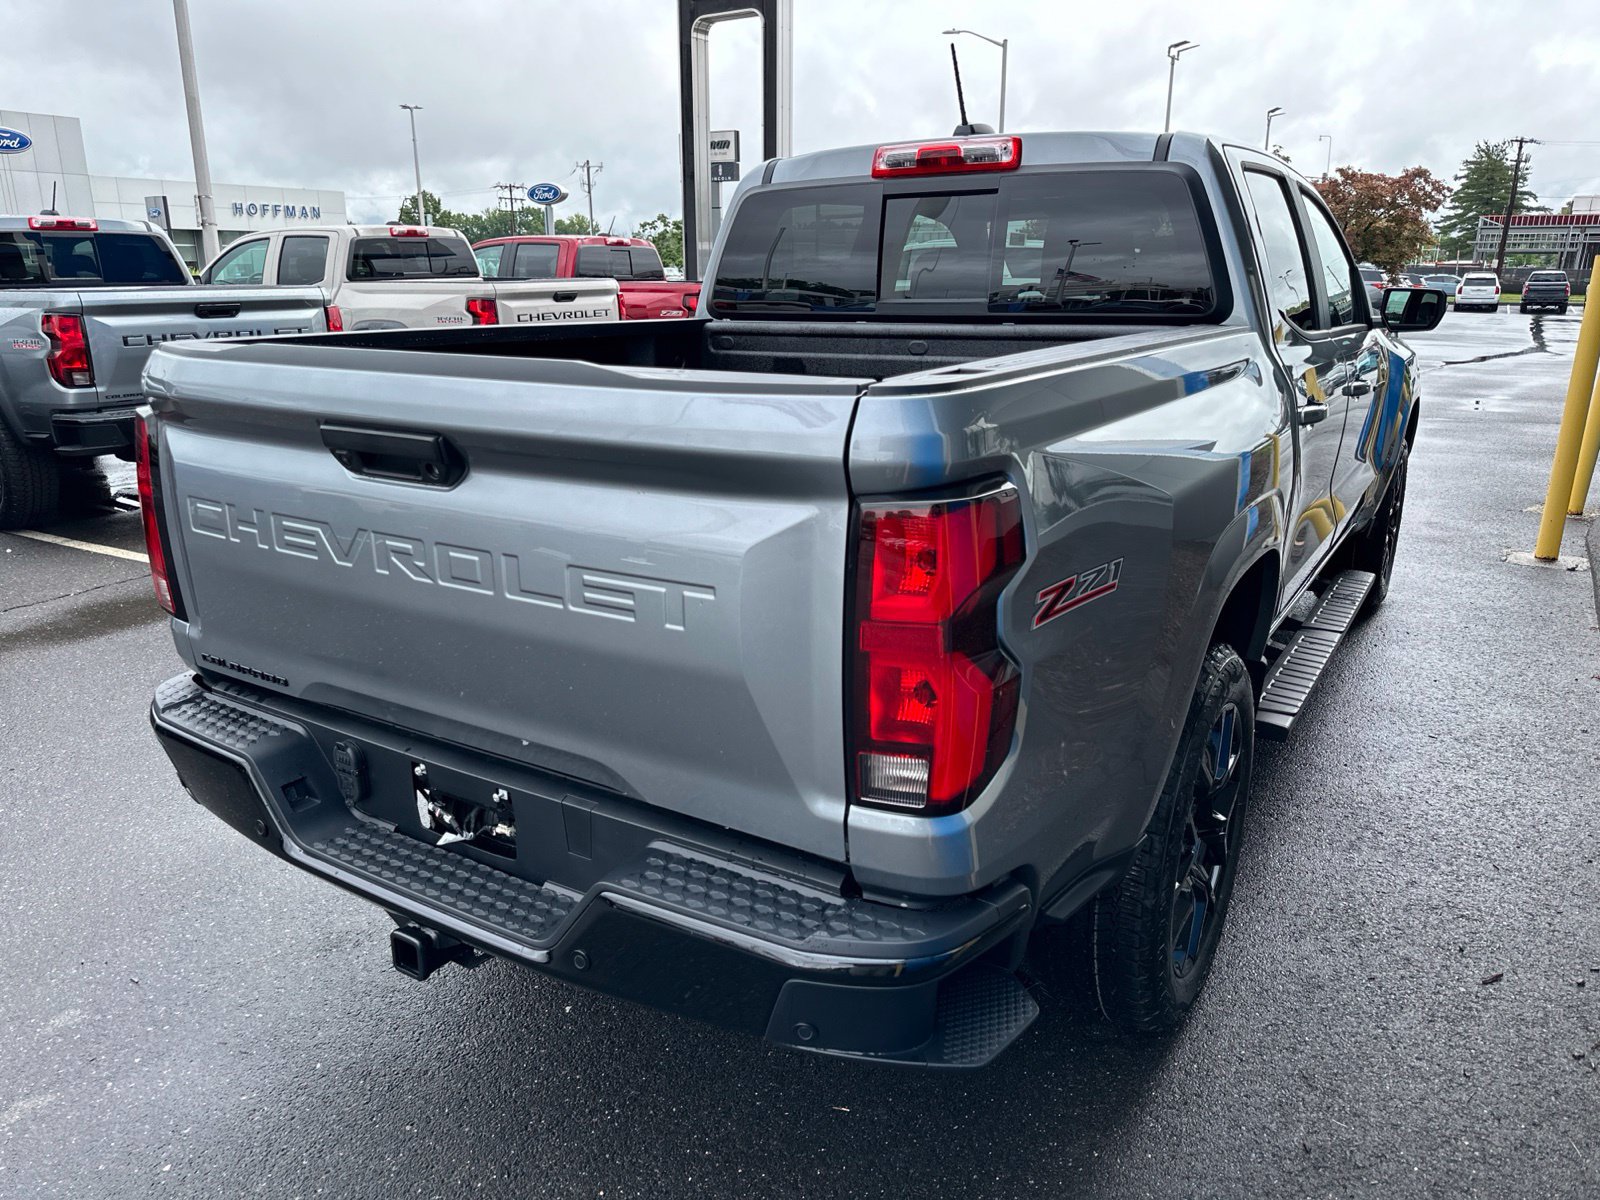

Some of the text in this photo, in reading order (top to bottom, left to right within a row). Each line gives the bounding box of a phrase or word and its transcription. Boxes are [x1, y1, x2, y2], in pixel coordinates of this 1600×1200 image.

[0, 132, 20, 148] rd
[533, 187, 555, 200] Ford
[231, 202, 321, 220] HOFFMAN
[517, 309, 611, 323] CHEVROLET
[187, 494, 717, 632] CHEVROLET
[1031, 557, 1125, 631] Z71
